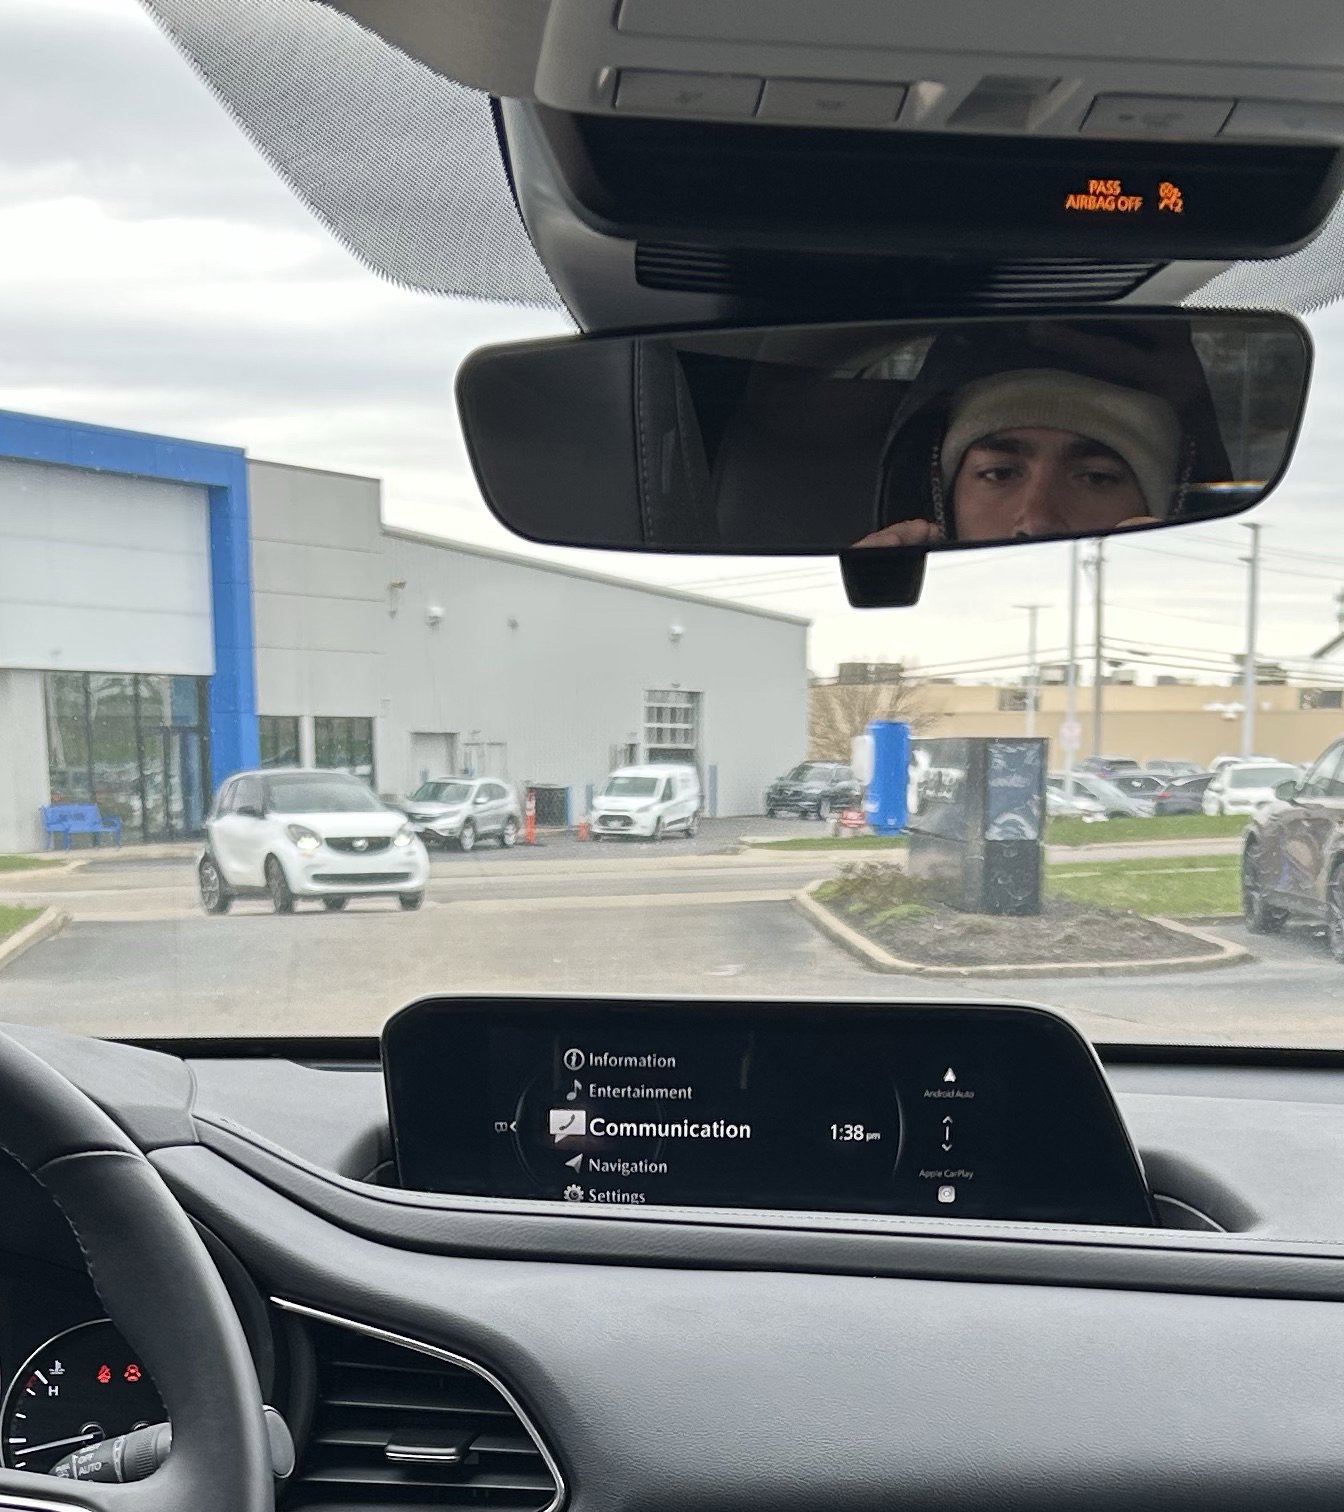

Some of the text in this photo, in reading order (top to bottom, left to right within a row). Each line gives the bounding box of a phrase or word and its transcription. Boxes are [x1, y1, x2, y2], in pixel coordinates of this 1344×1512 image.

[1088, 179, 1121, 195] PASS
[1065, 194, 1143, 211] AIRBAG OFF
[588, 1052, 676, 1068] Information
[588, 1083, 693, 1099] Entertainment
[589, 1117, 751, 1139] Communication
[830, 1123, 881, 1142] 1:38 pm
[588, 1158, 668, 1177] Navigation
[918, 1169, 943, 1179] Apple
[588, 1188, 646, 1204] Settings
[48, 1386, 59, 1397] H
[78, 1462, 102, 1476] AUTO
